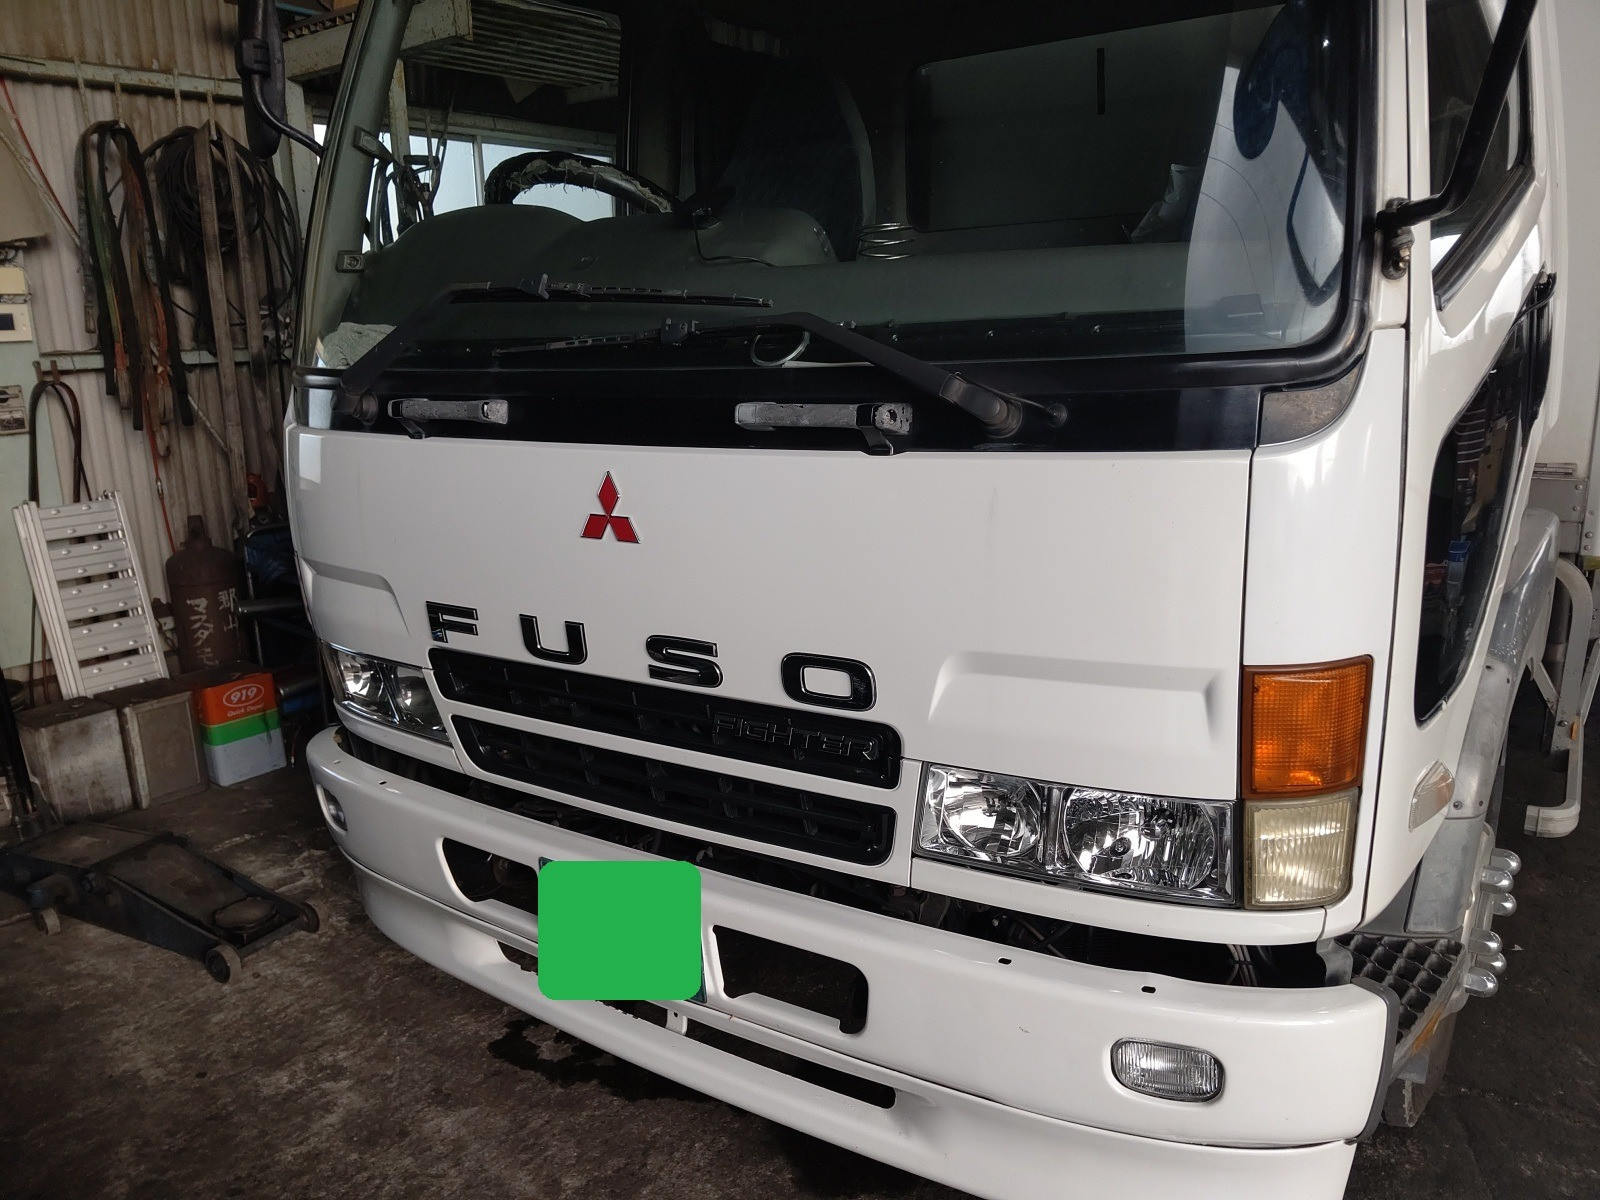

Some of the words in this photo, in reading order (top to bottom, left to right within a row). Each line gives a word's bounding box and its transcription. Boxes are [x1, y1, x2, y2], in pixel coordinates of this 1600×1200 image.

[426, 601, 878, 711] FUSO
[230, 686, 257, 704] 919
[712, 713, 879, 761] FIGHTER
